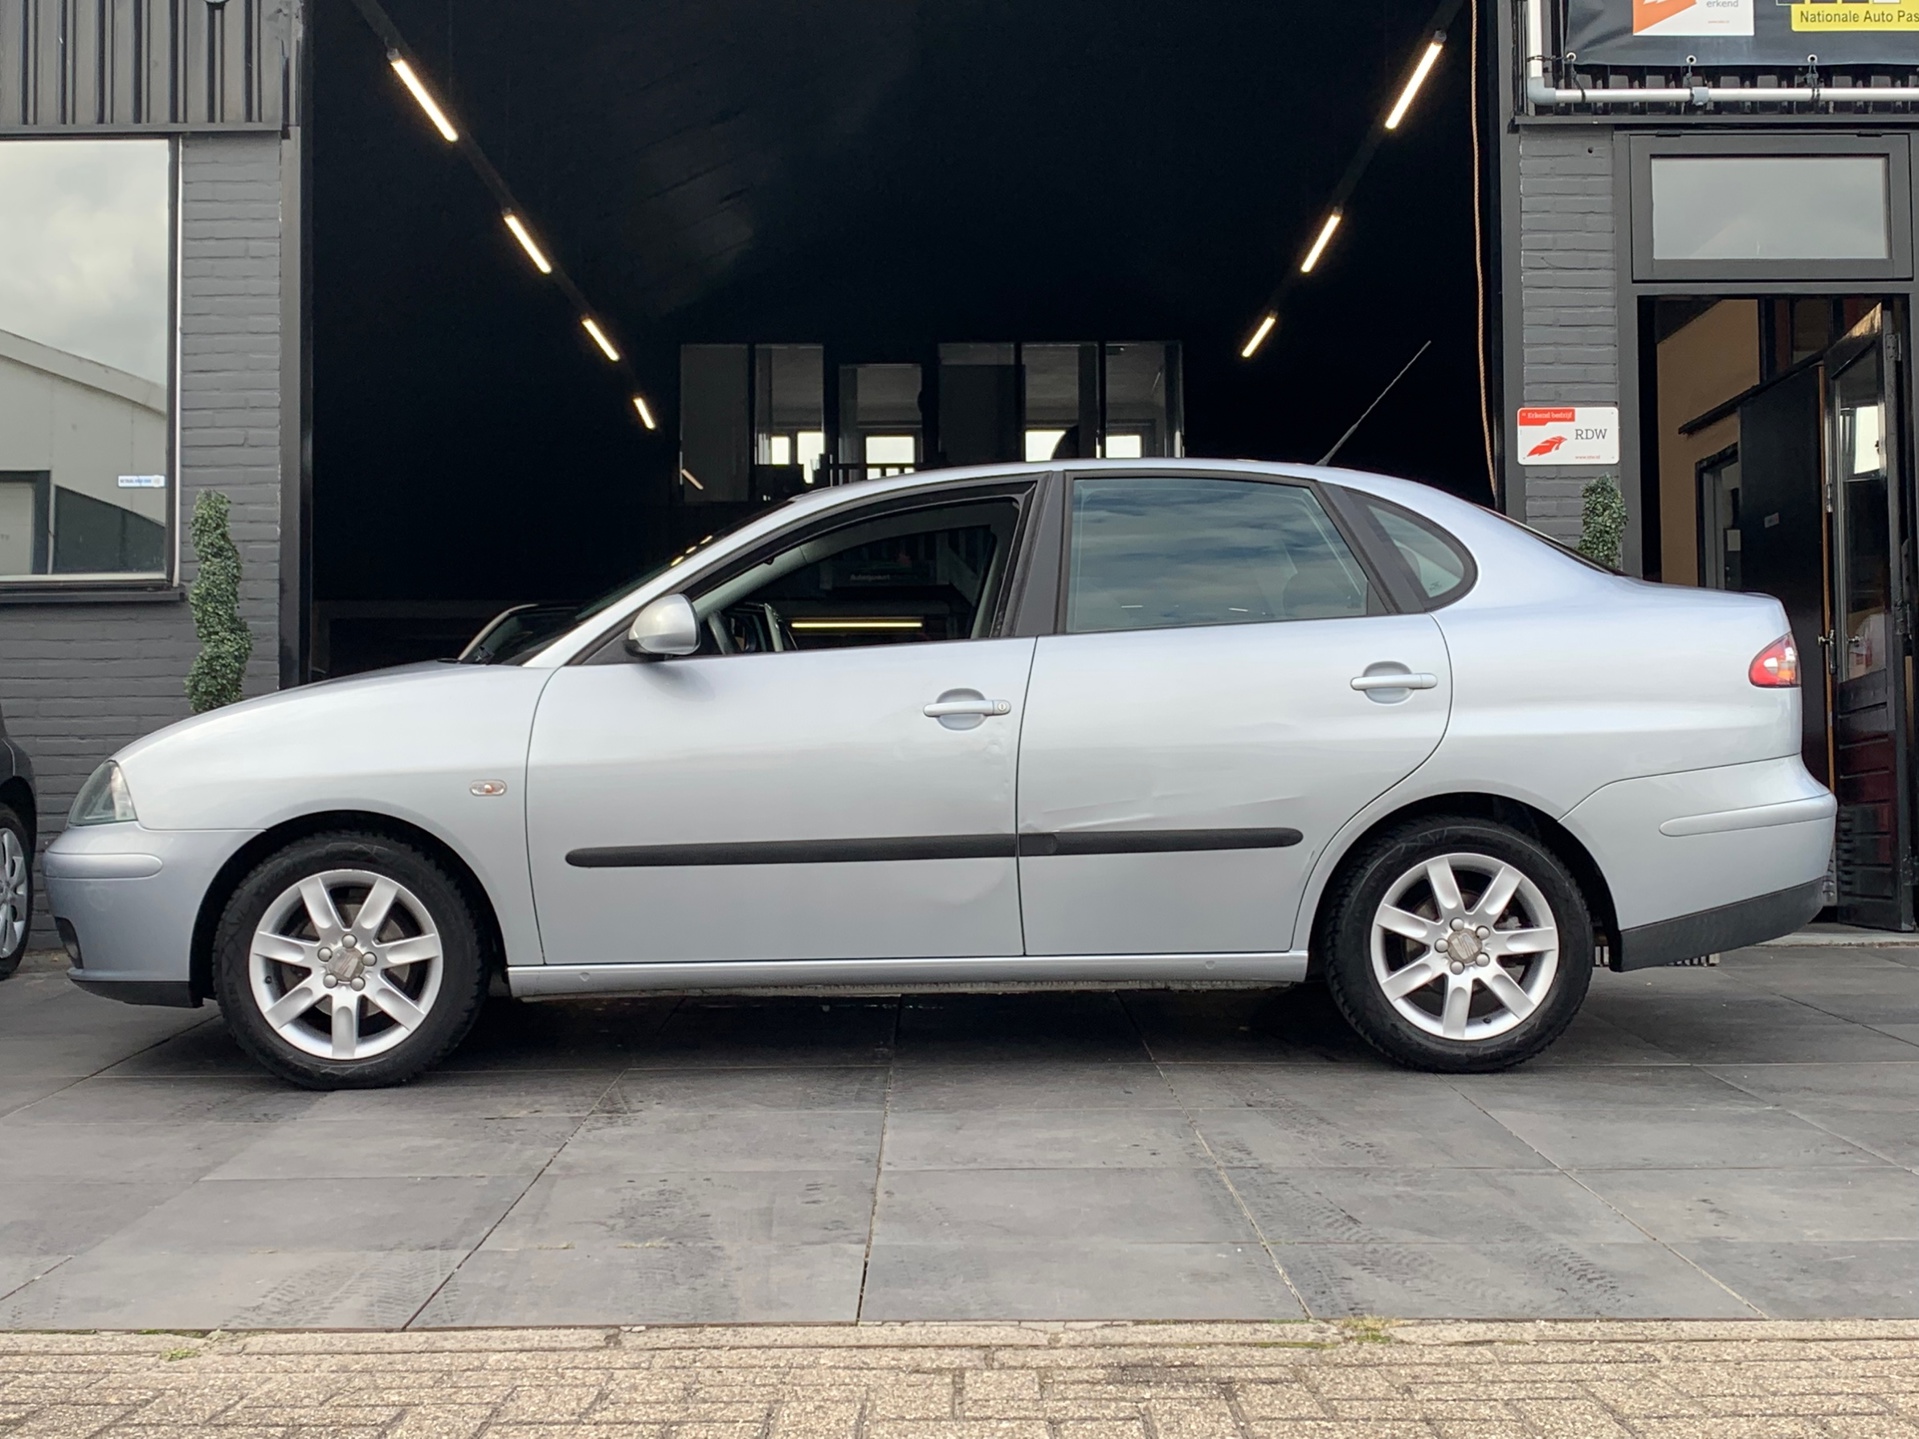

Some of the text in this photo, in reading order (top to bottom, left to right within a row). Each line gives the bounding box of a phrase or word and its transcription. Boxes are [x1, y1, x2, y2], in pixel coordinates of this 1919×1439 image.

[1706, 0, 1739, 8] erkend
[1800, 10, 1919, 23] Nationale Auto Pas
[1574, 428, 1608, 440] RDW
